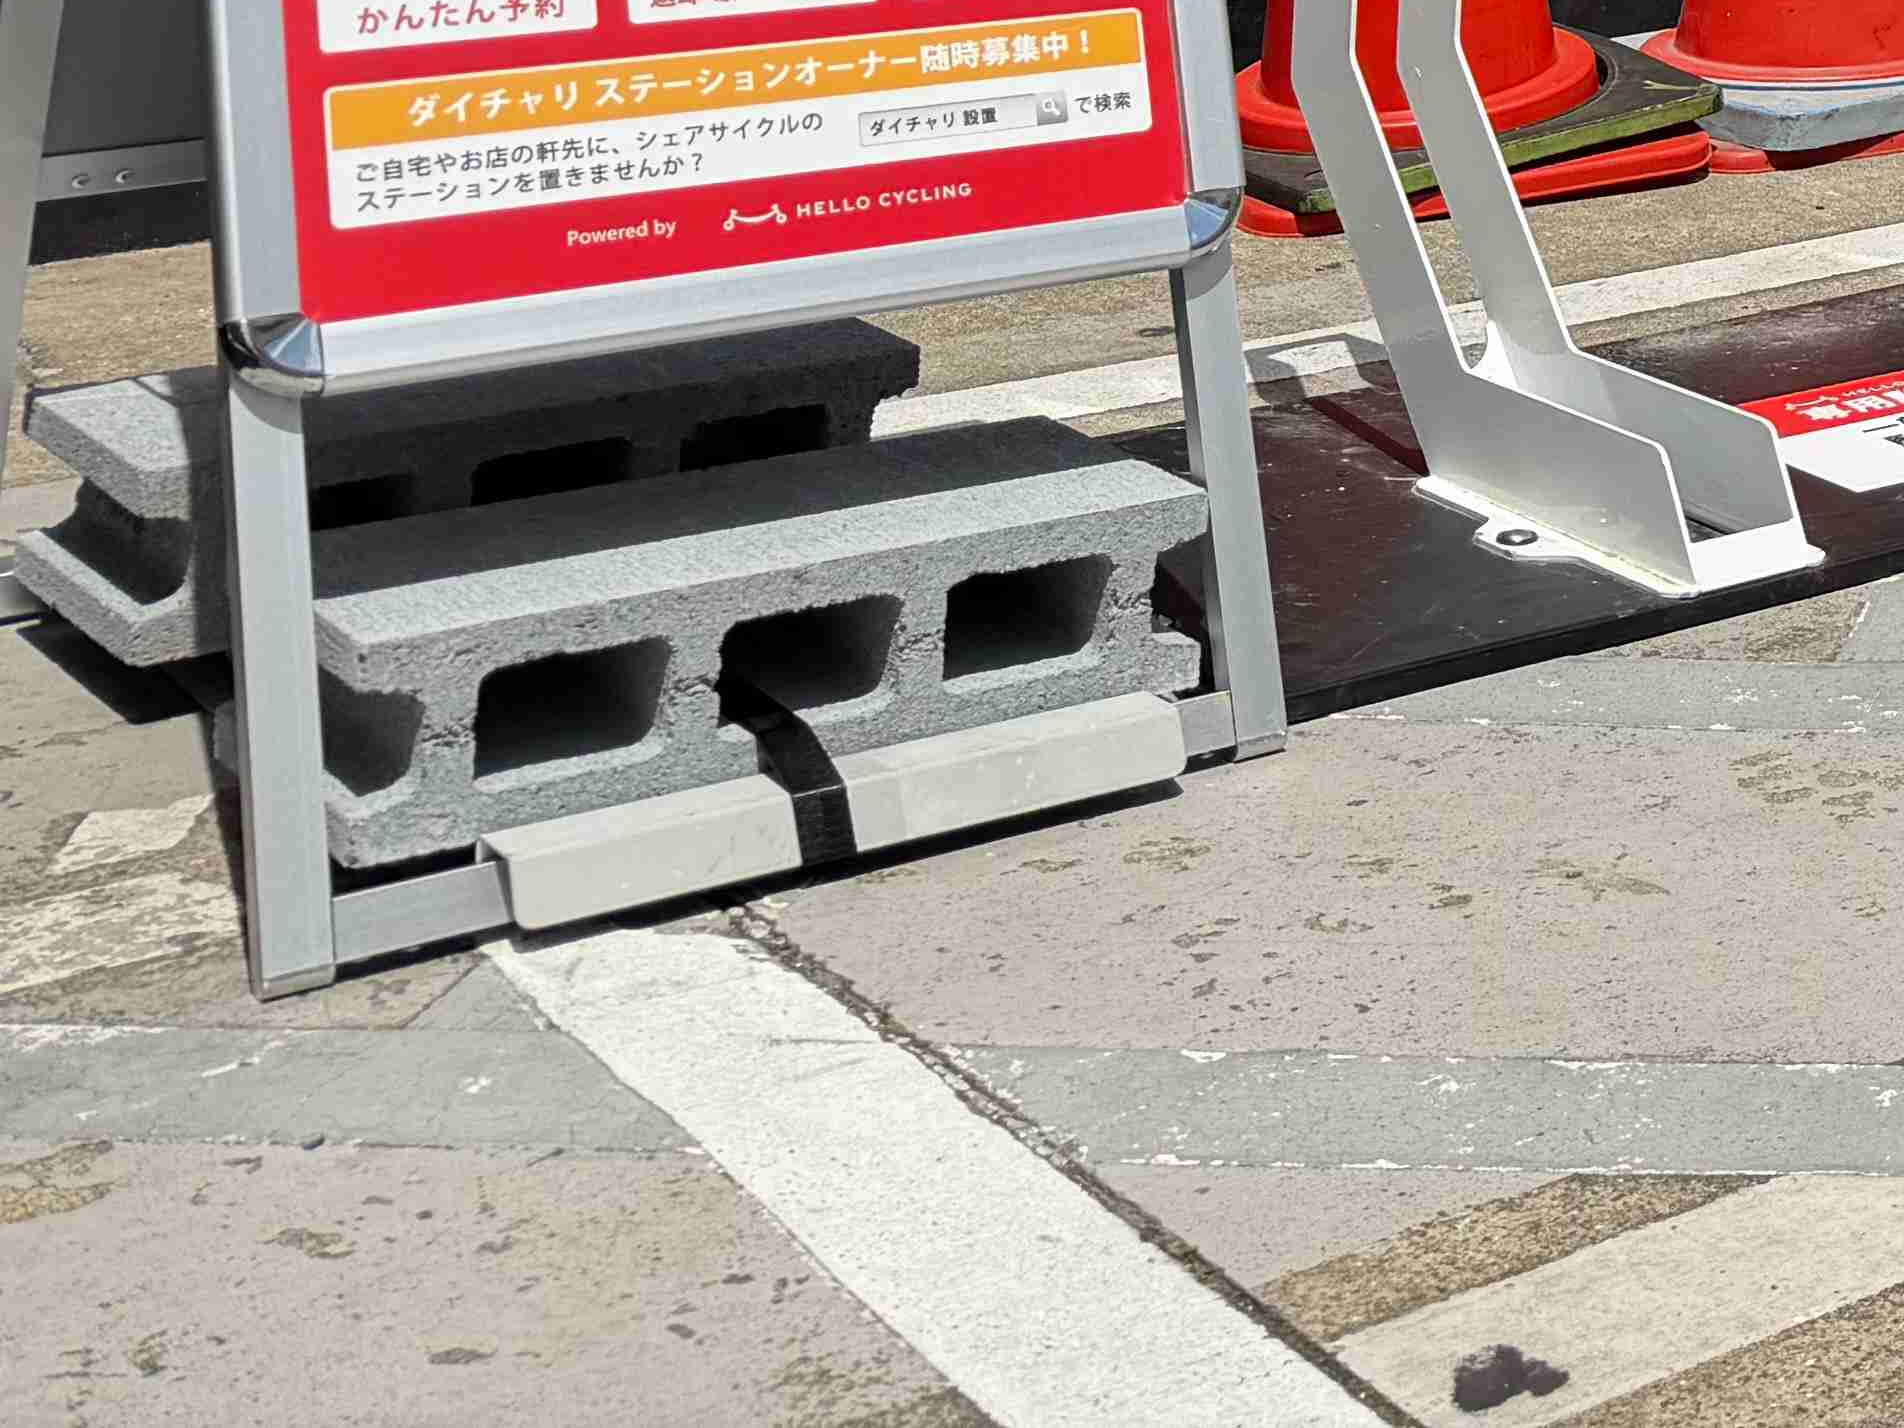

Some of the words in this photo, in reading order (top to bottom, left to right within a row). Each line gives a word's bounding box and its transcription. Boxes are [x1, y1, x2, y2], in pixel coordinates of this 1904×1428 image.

[408, 83, 580, 128] ダイチャリ
[594, 29, 1091, 108] ステーションオーナー随時募集中！
[869, 111, 956, 138] ダイチャリ
[962, 106, 999, 127] 設置
[1074, 90, 1133, 115] で検索
[355, 111, 824, 184] ご自宅やお店の軒先に、シェアサイクルの
[356, 152, 705, 214] ステーションを置きませんか？
[795, 194, 872, 220] HELLO
[878, 181, 974, 208] CYCLING
[566, 220, 650, 247] Powered
[653, 219, 678, 239] by
